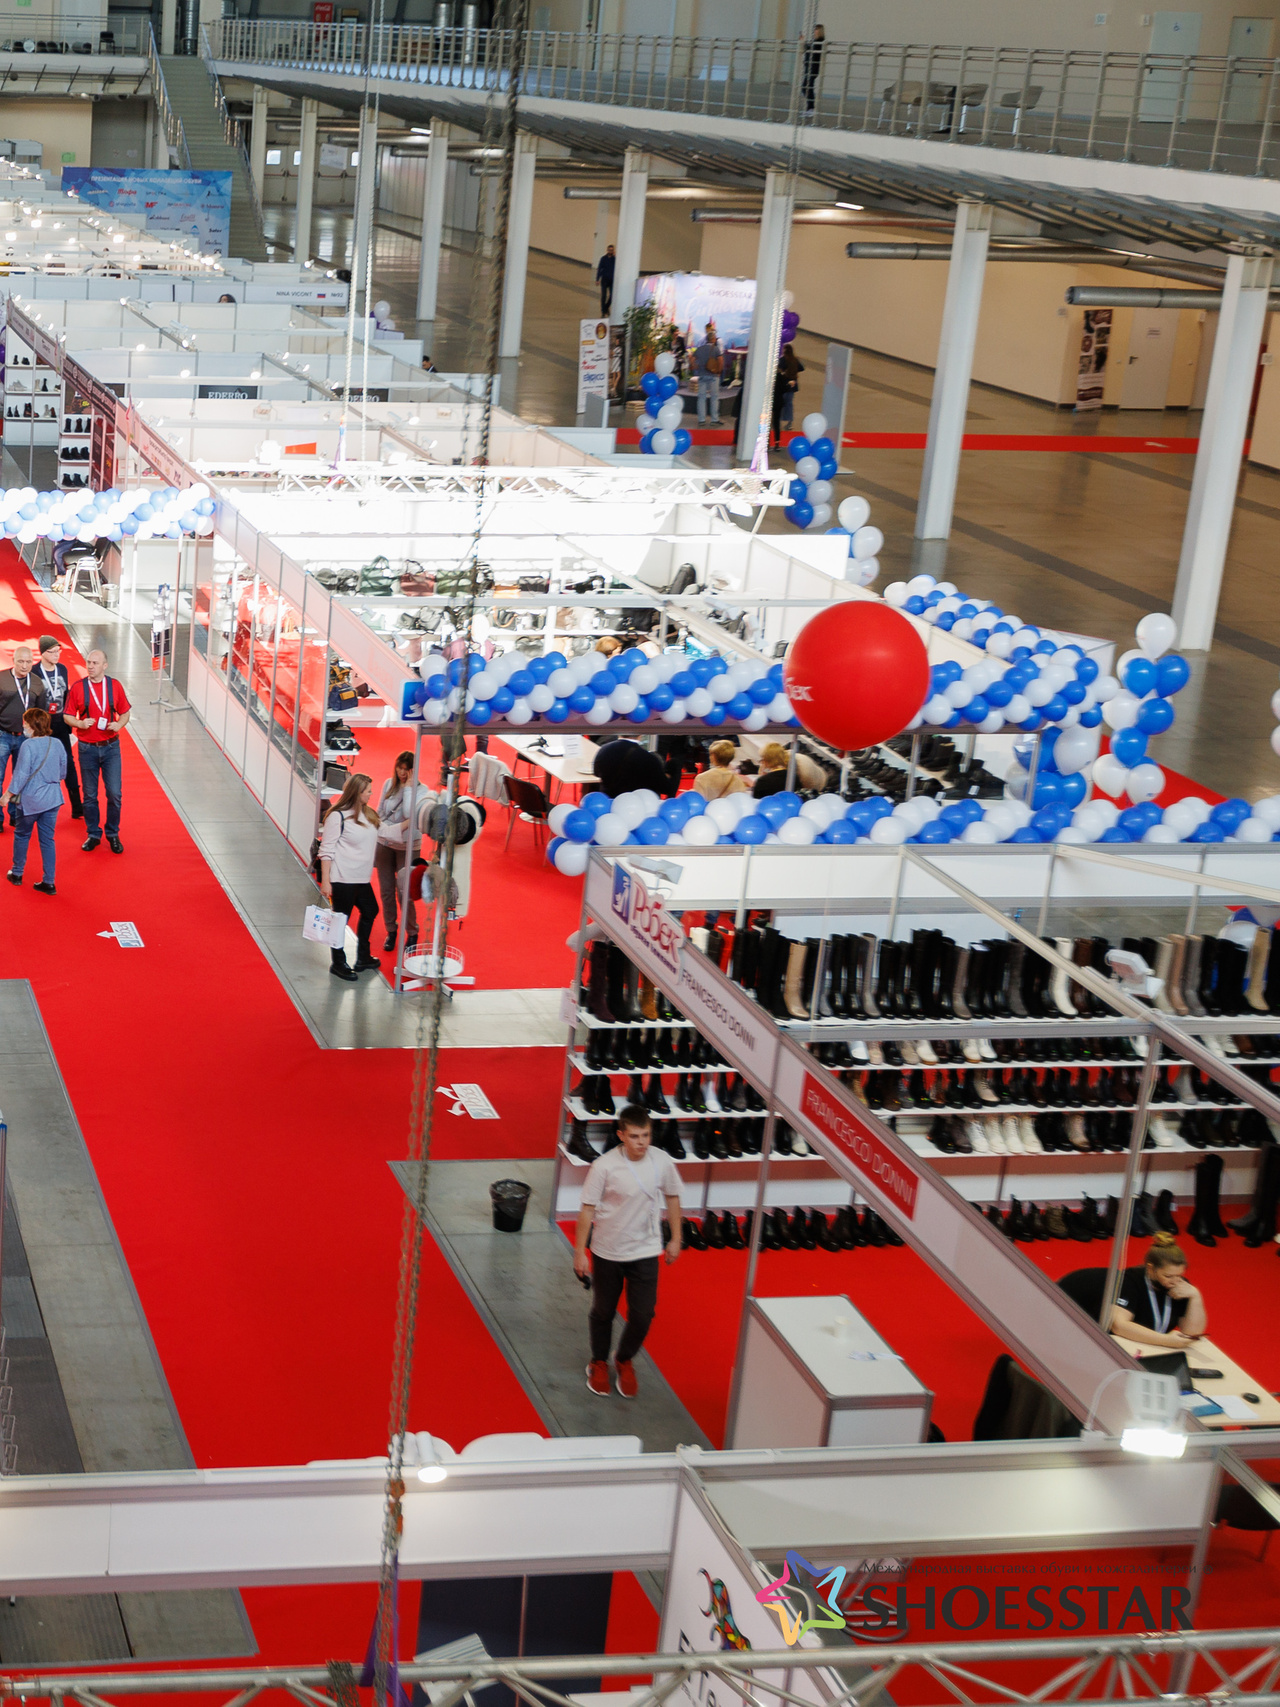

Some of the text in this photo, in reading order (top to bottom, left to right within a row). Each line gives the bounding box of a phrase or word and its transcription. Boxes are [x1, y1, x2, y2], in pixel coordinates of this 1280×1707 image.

[632, 879, 680, 964] Робек
[682, 968, 756, 1051] FRANCESCO DONNI
[806, 1089, 914, 1206] FRANCESCO DONNI
